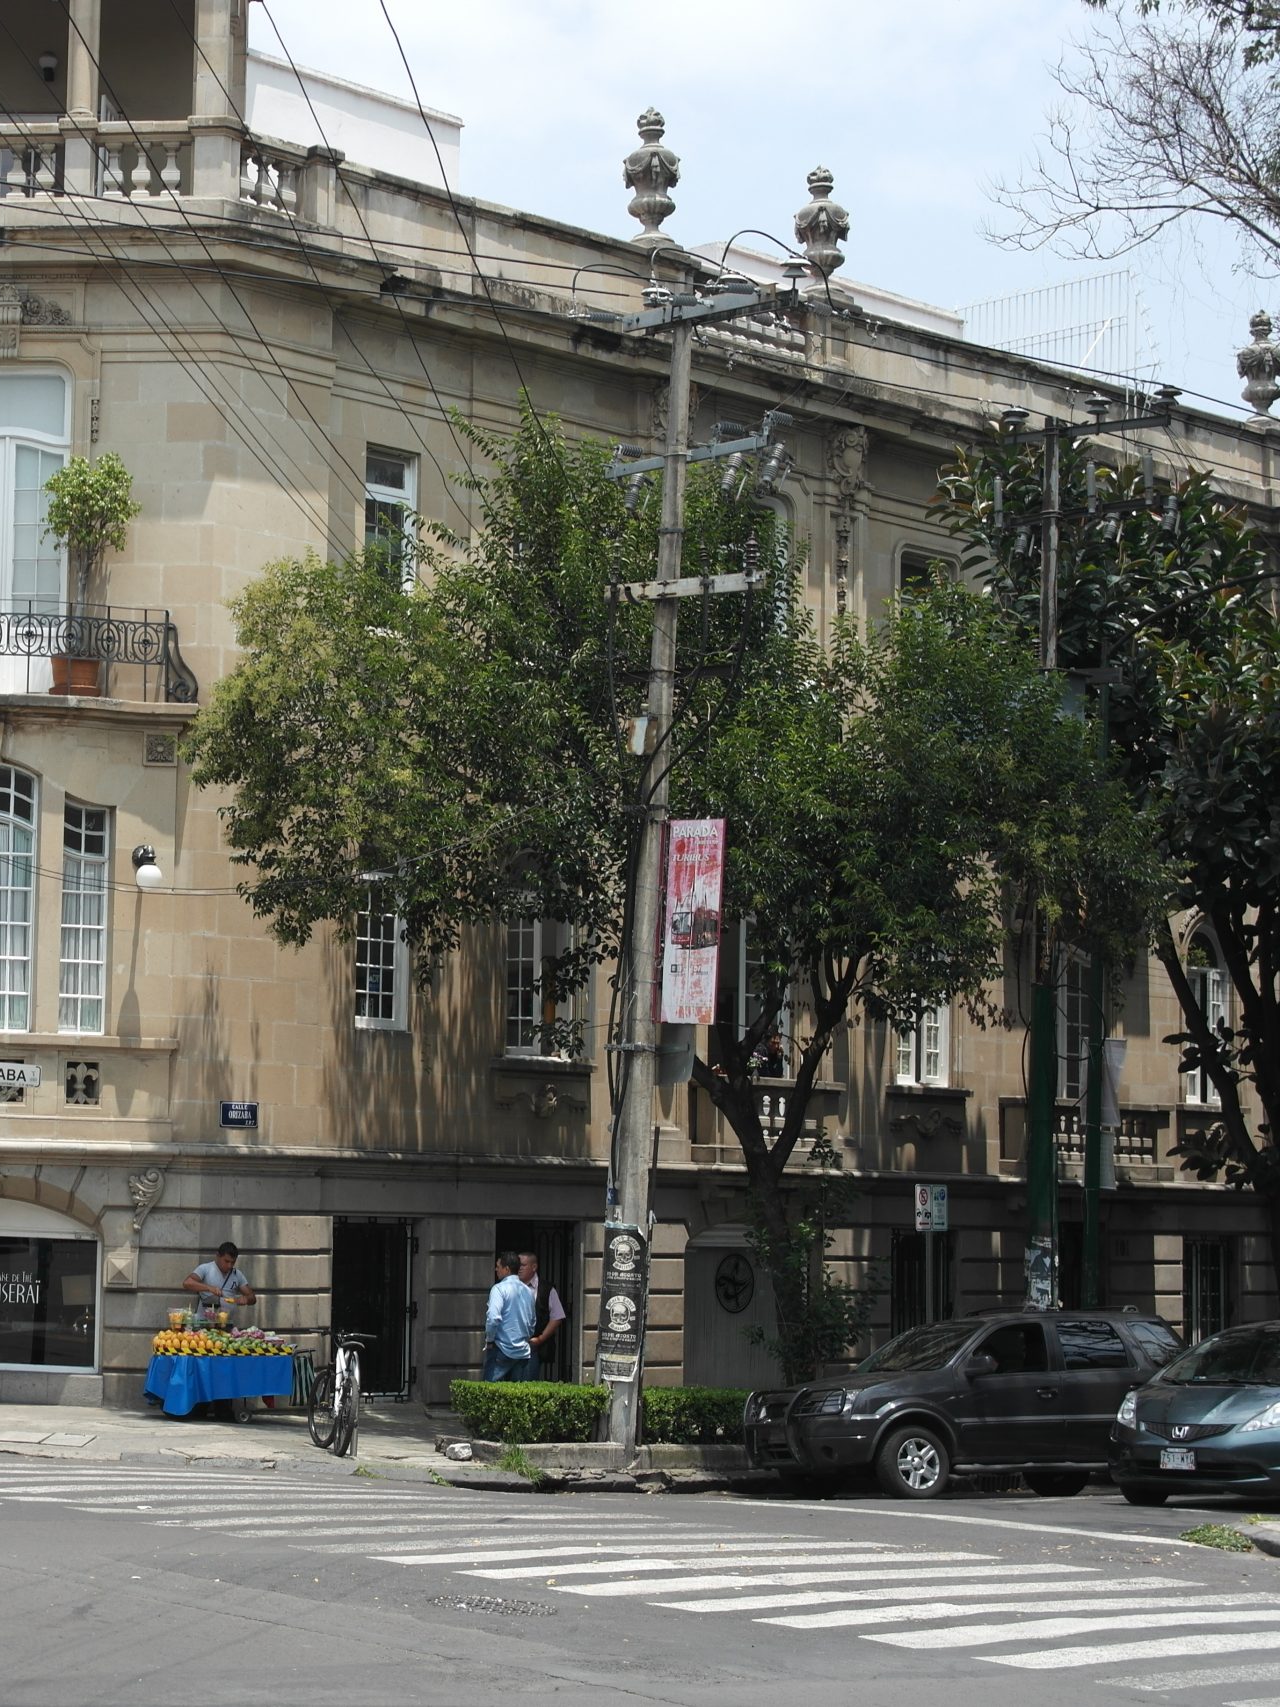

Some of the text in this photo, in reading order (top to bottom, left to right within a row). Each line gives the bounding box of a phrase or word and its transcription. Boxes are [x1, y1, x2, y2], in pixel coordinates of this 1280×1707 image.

[672, 825, 718, 838] PARADA
[671, 853, 710, 862] TURIBUS
[228, 1110, 252, 1119] ORIZABA
